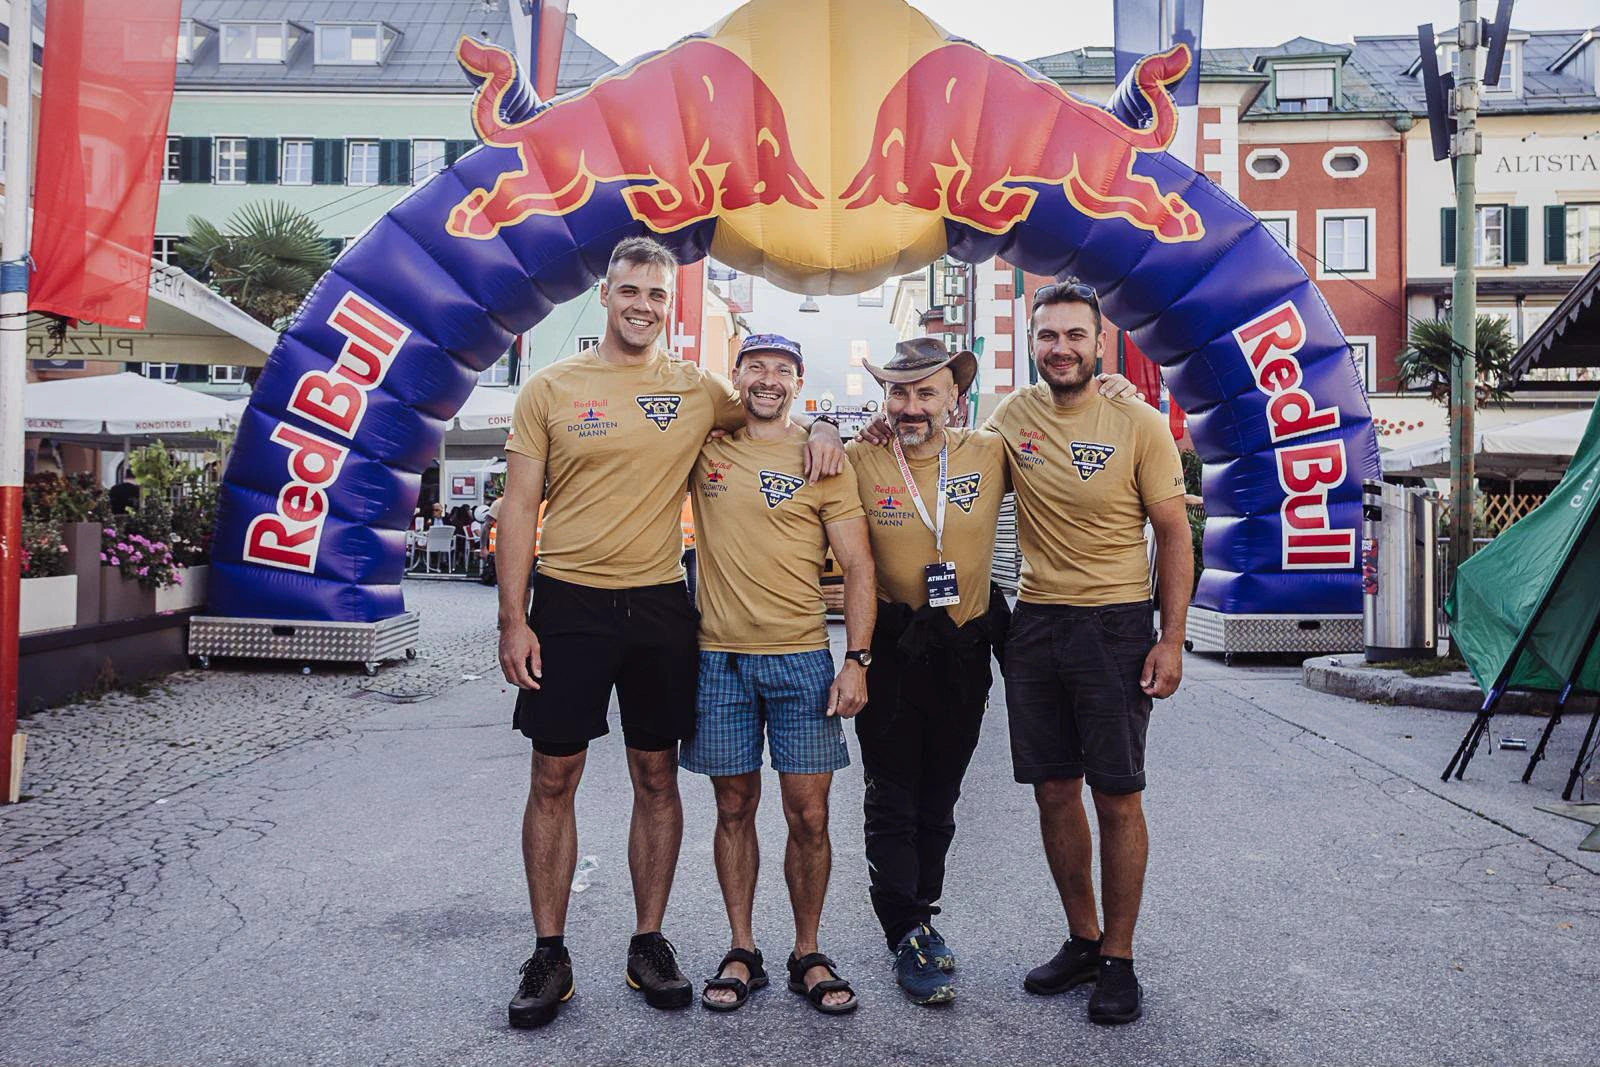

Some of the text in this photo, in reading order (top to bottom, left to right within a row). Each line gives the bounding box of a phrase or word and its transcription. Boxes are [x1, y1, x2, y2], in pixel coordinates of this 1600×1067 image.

[1495, 154, 1598, 173] ALTSTA
[574, 399, 608, 408] Red Bull
[135, 420, 192, 430] KONDITOREI
[567, 421, 618, 432] DOLOMITEN
[245, 293, 409, 571] Red Bull
[578, 429, 607, 438] MANN
[1020, 428, 1046, 440] Red Bull
[1234, 302, 1354, 569] Red Bull
[874, 485, 906, 495] Red Bull
[868, 508, 915, 519] DOLOMITEN
[877, 519, 903, 527] MANN
[927, 573, 956, 582] ATHLETE
